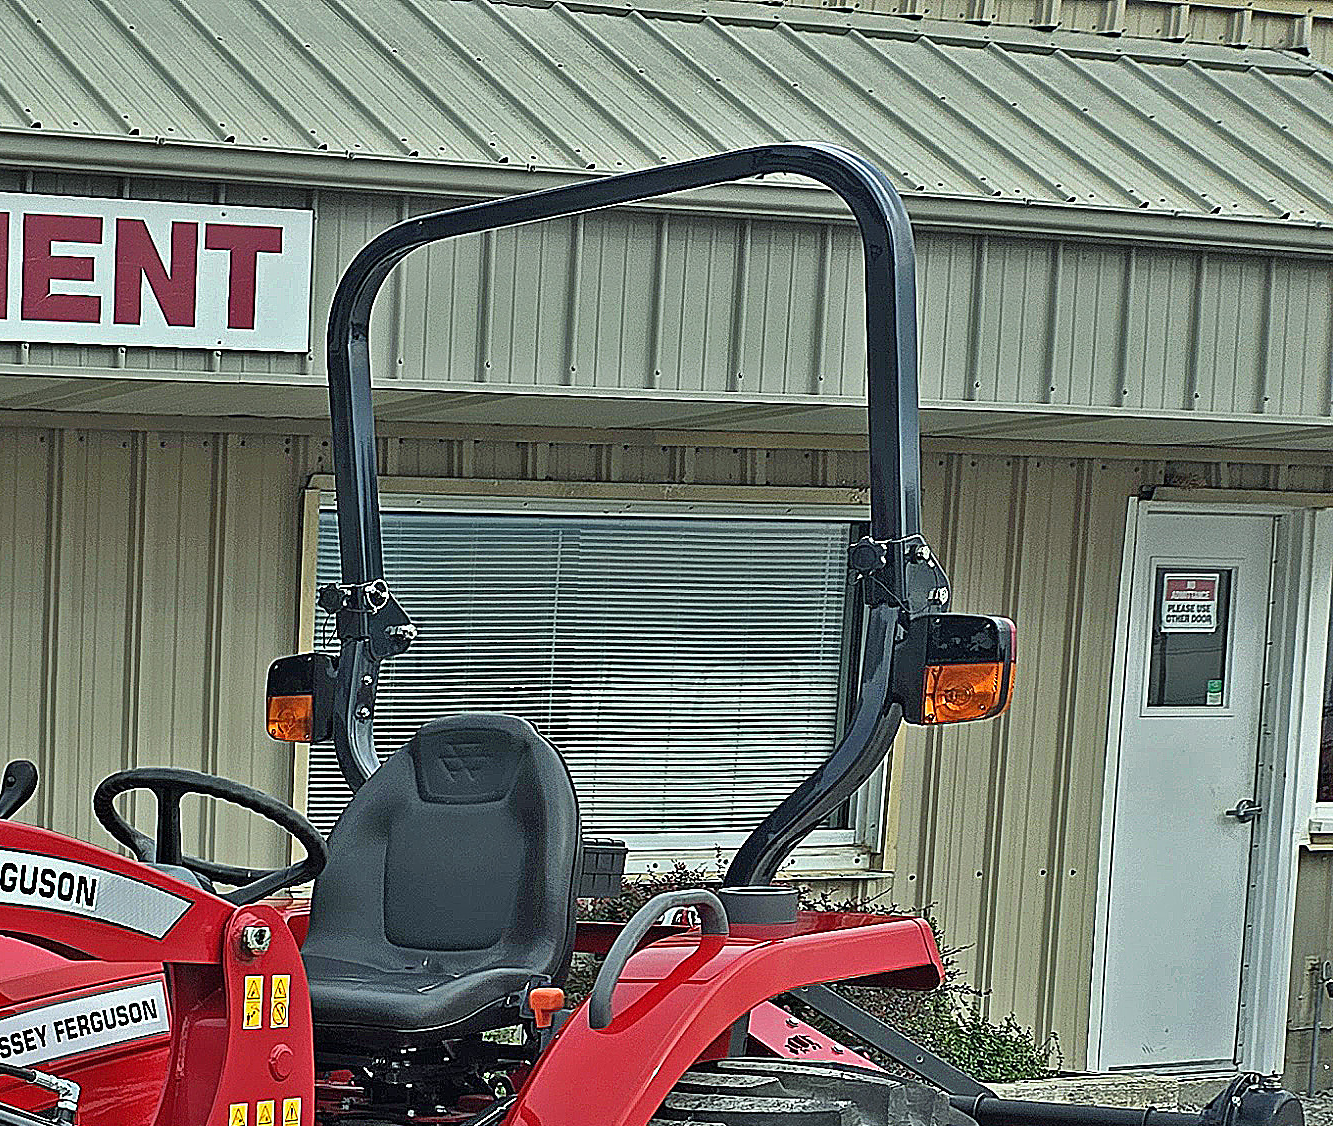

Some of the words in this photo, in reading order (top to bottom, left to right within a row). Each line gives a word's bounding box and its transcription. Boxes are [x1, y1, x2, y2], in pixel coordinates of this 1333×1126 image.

[1167, 604, 1195, 613] PLEASE
[1196, 604, 1212, 613] USE
[1166, 614, 1190, 623] OTHER
[1191, 614, 1212, 624] DOOR
[53, 998, 158, 1043] FERGUSON
